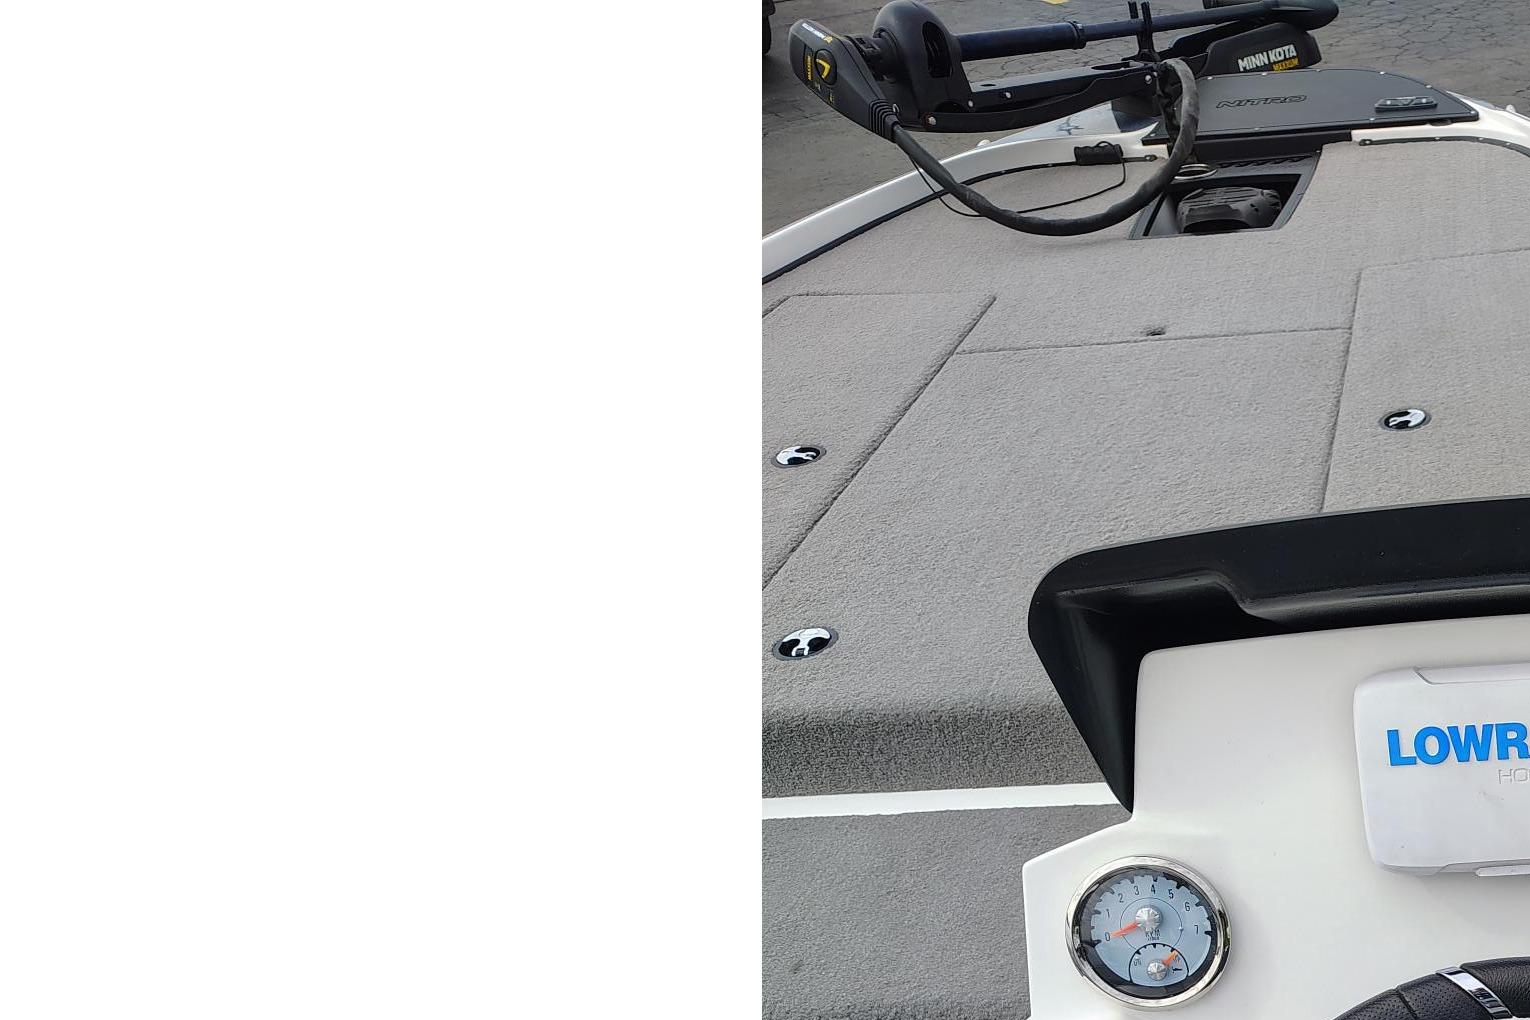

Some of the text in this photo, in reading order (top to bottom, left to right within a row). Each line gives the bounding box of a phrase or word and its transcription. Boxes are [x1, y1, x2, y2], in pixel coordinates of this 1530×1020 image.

[1238, 44, 1297, 71] MINN KOTA
[1216, 95, 1307, 108] NITRO
[1133, 885, 1140, 896] 3
[1150, 884, 1156, 895] 4
[1168, 888, 1174, 899] 5
[1117, 892, 1124, 903] 2
[1184, 901, 1191, 912] 6
[1193, 924, 1199, 935] 7
[1104, 931, 1111, 942] 0
